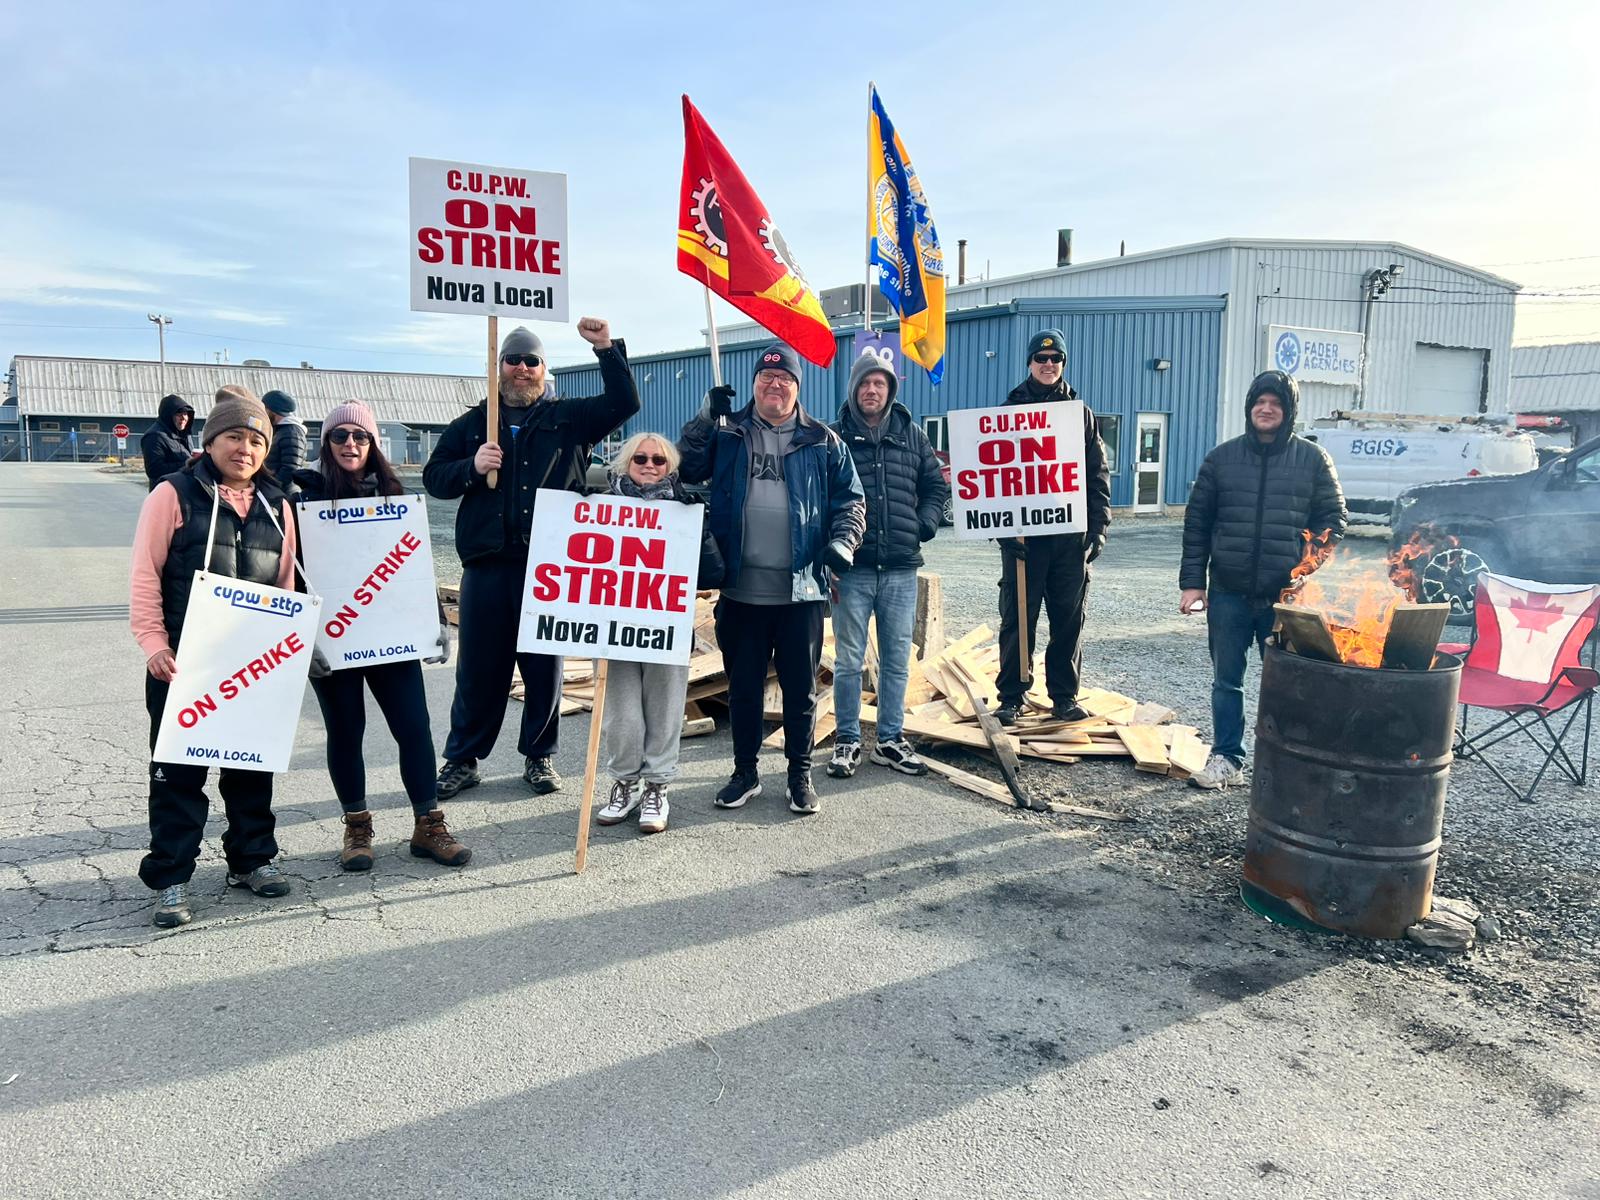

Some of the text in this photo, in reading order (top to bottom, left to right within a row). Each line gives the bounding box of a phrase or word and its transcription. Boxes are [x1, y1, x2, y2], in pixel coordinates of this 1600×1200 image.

[447, 170, 531, 198] C.U.P.W.
[445, 199, 536, 235] ON
[418, 227, 561, 275] STRIKE
[427, 276, 553, 309] Nova Local
[1304, 341, 1338, 358] FADER
[1303, 358, 1355, 373] AGENCIES
[113, 428, 129, 436] STOP
[979, 410, 1051, 434] C.U.P.W.
[978, 436, 1057, 466] ON
[1351, 439, 1394, 456] BGIS
[957, 462, 1080, 500] STRIKE
[574, 502, 663, 530] C.U.P.W.
[966, 503, 1073, 530] Nova Local
[567, 532, 667, 570] ON
[324, 531, 421, 639] ON STRIKE
[533, 563, 689, 613] STRIKE
[213, 586, 303, 617] cupw sttp
[536, 614, 675, 651] Nova Local
[343, 644, 417, 662] NOVA LOCAL
[177, 632, 305, 729] ON STRIKE
[186, 746, 263, 763] NOVA LOCAL
